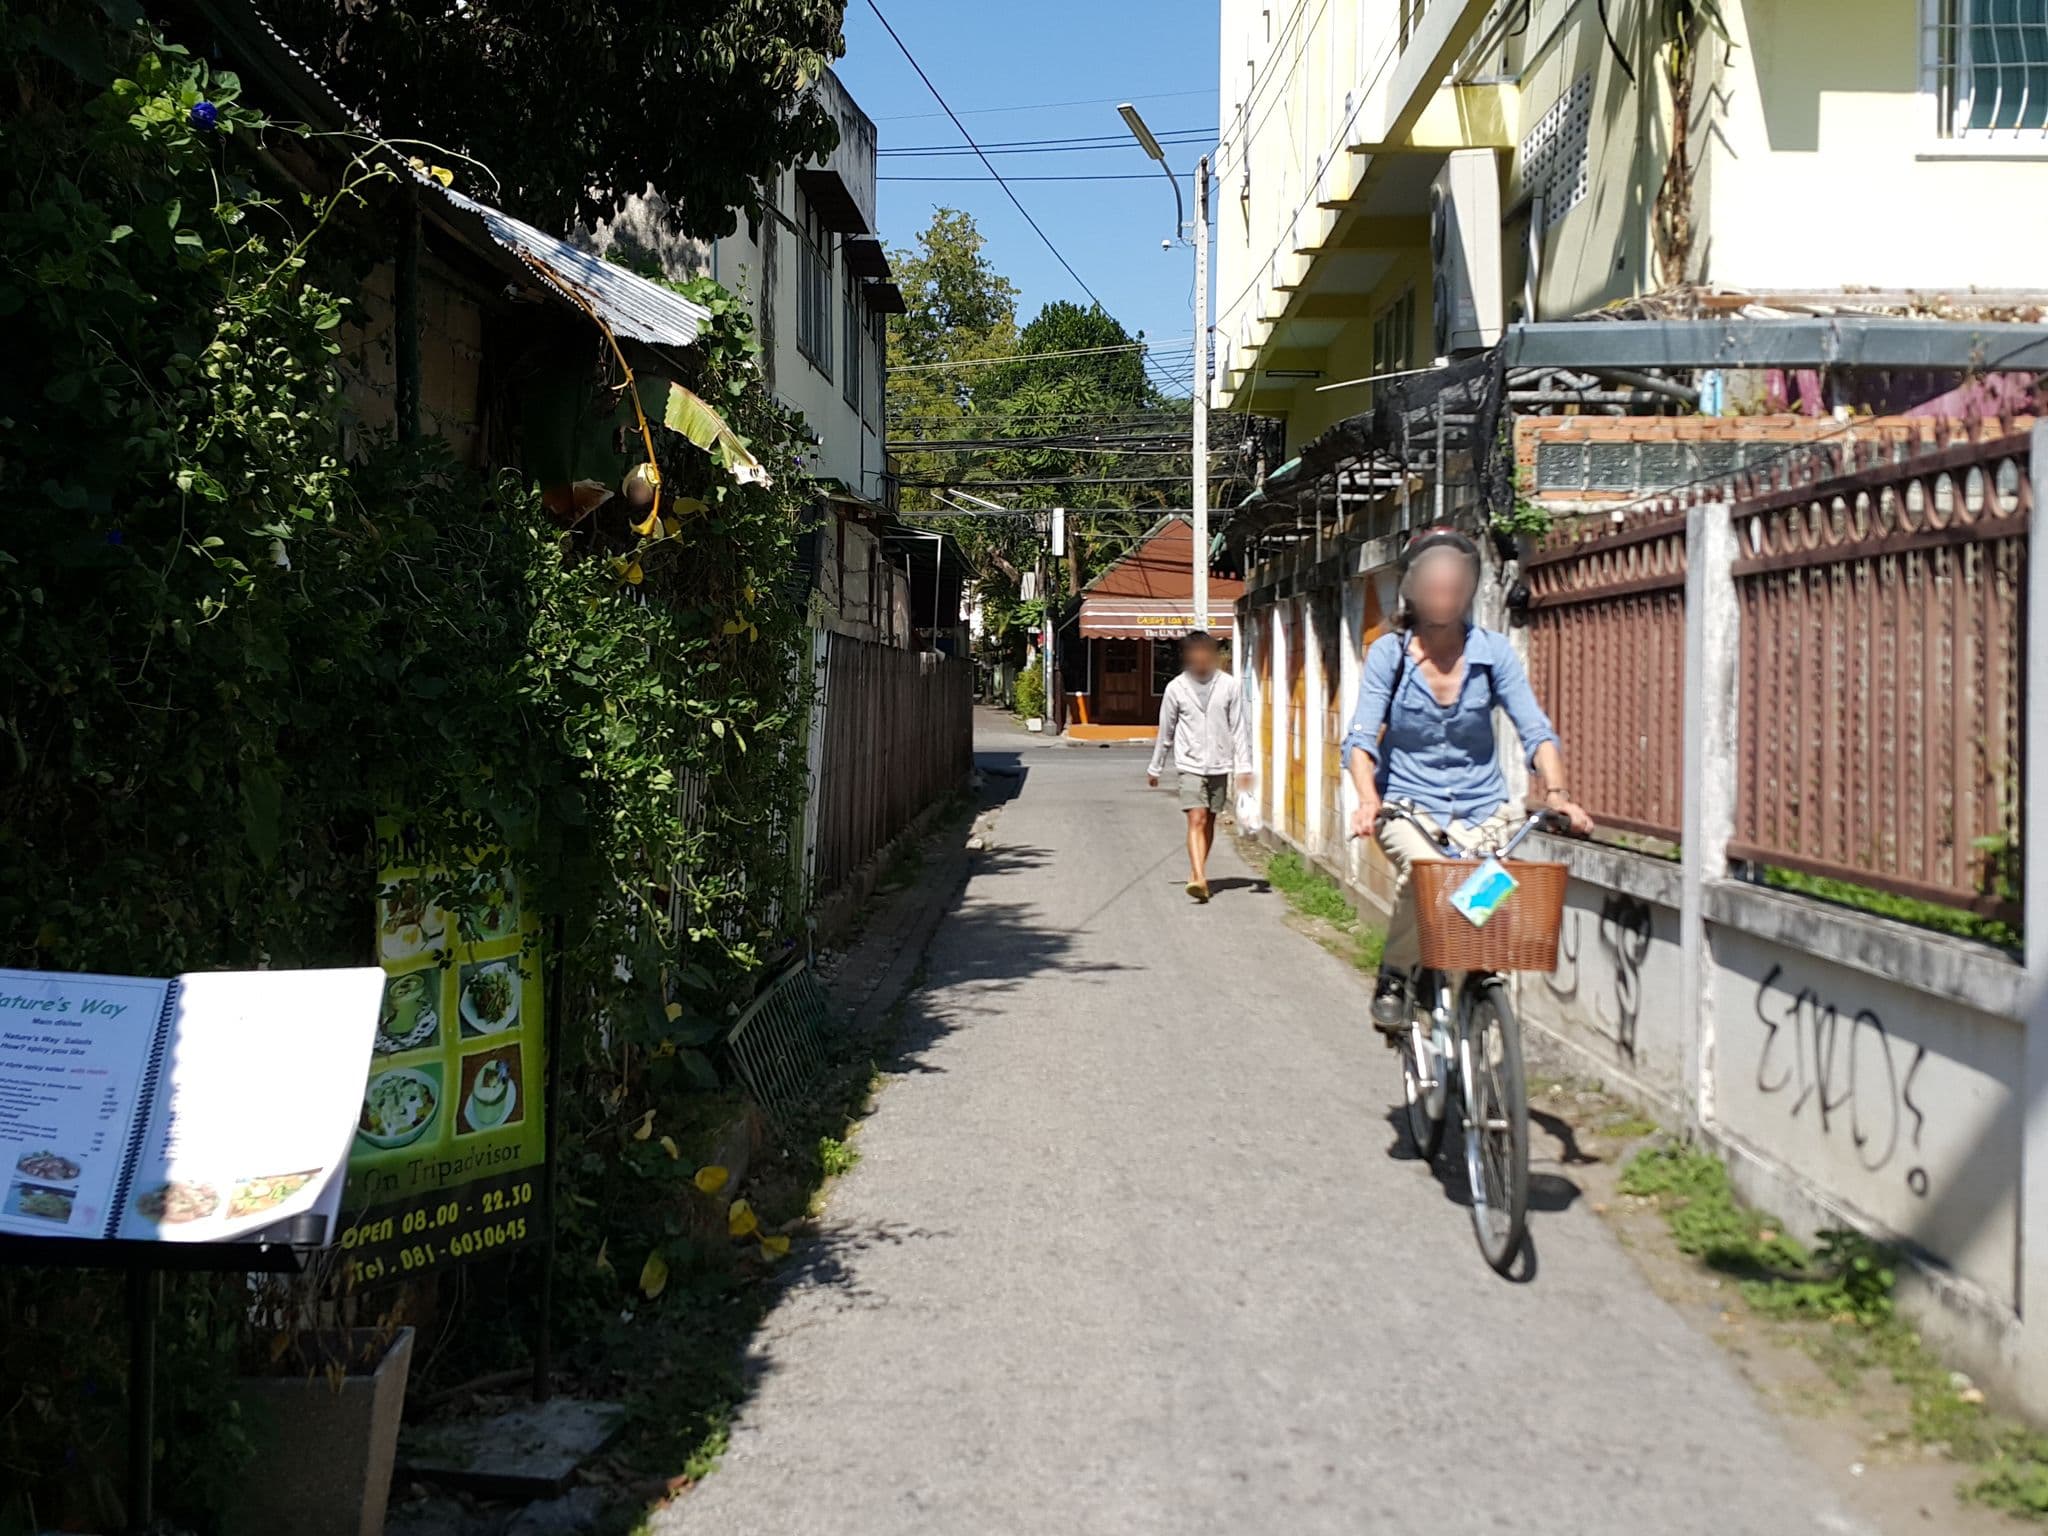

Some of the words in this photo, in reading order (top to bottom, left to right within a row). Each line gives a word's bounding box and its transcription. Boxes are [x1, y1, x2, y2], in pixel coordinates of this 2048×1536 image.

[0, 992, 72, 1012] ature's
[80, 997, 128, 1018] Way
[41, 1035, 61, 1045] Way
[364, 1168, 399, 1193] On
[408, 1144, 521, 1186] Tripadvisor
[402, 1201, 459, 1234] 08.00
[481, 1182, 533, 1214] 22.30
